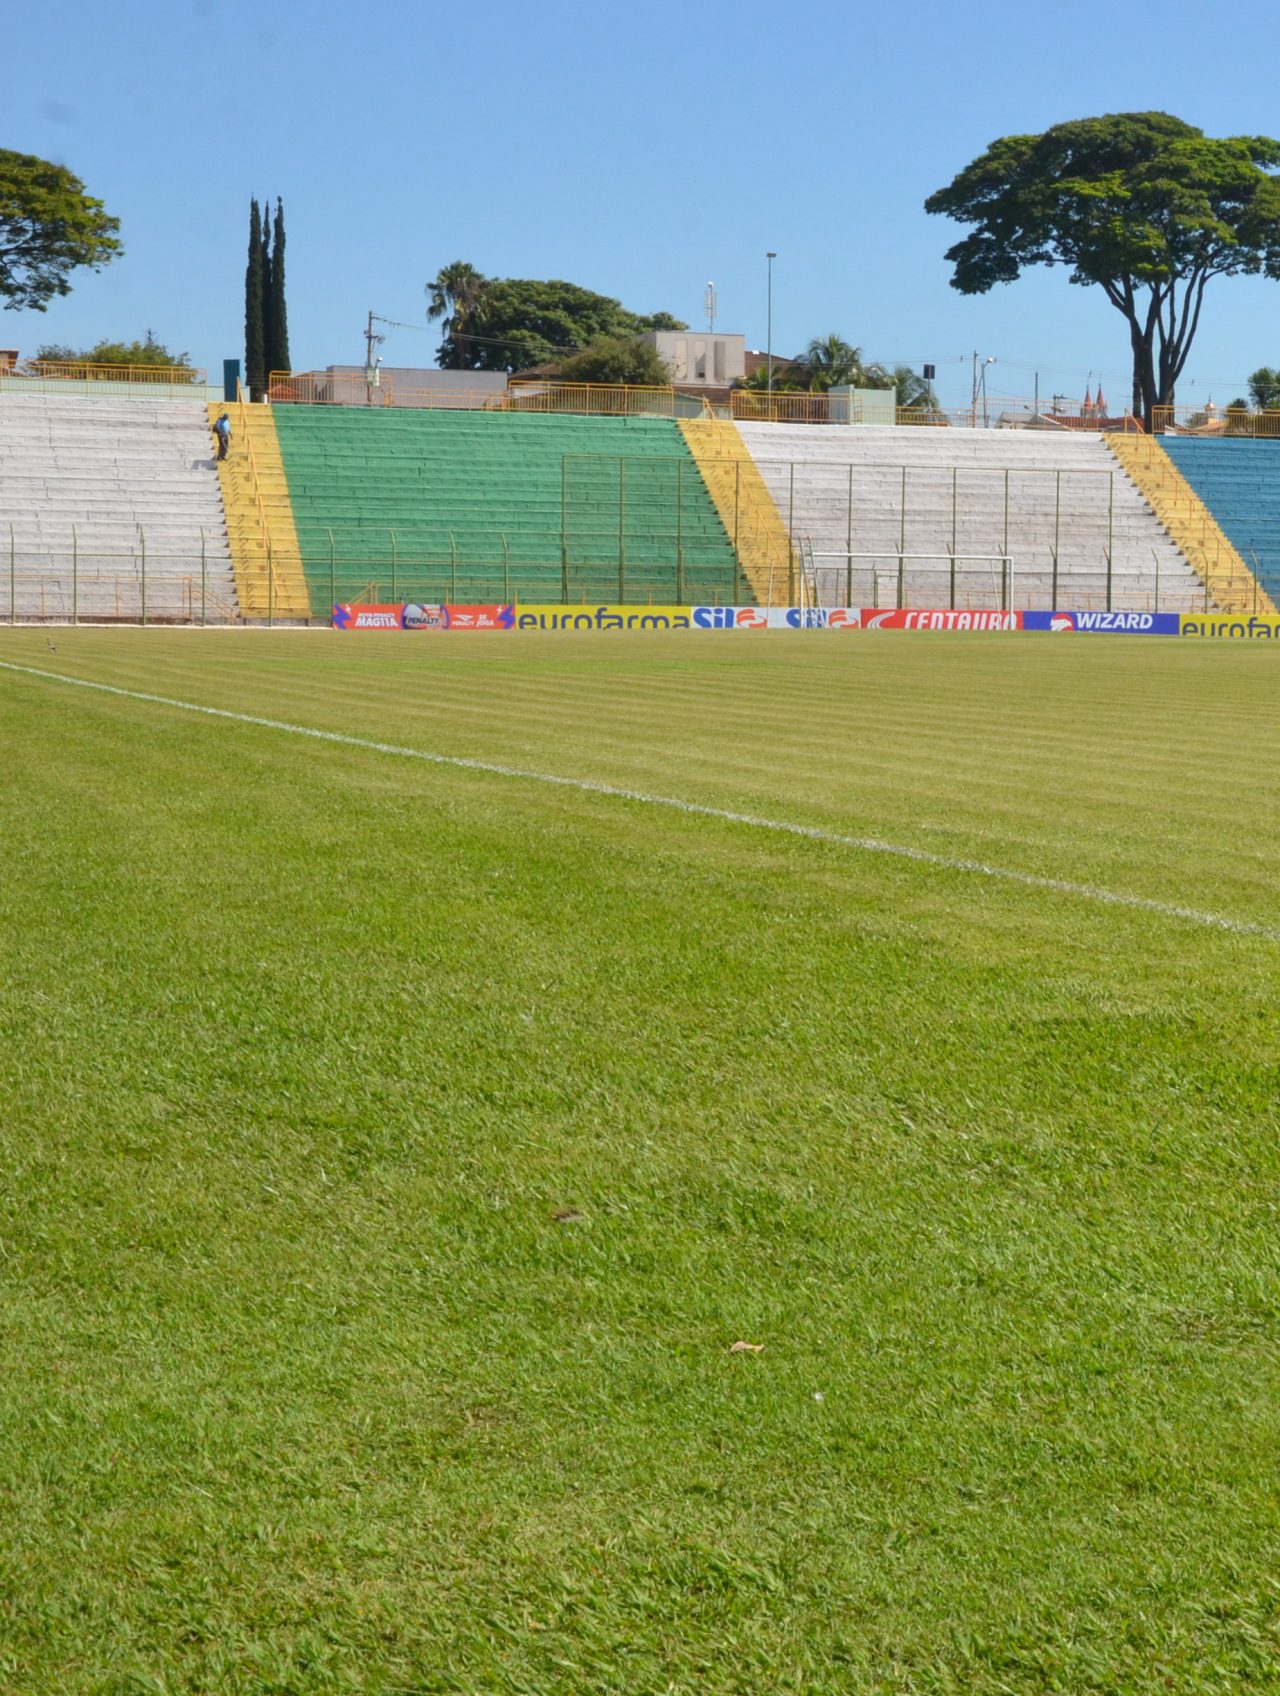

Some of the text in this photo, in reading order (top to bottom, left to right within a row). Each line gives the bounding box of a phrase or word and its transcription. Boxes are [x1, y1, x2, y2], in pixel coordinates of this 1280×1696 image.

[518, 607, 690, 629] eurofarma
[693, 608, 735, 628] Sil
[786, 609, 827, 628] Sil
[904, 612, 1018, 630] CENTAURO
[1076, 613, 1153, 629] WIZARD
